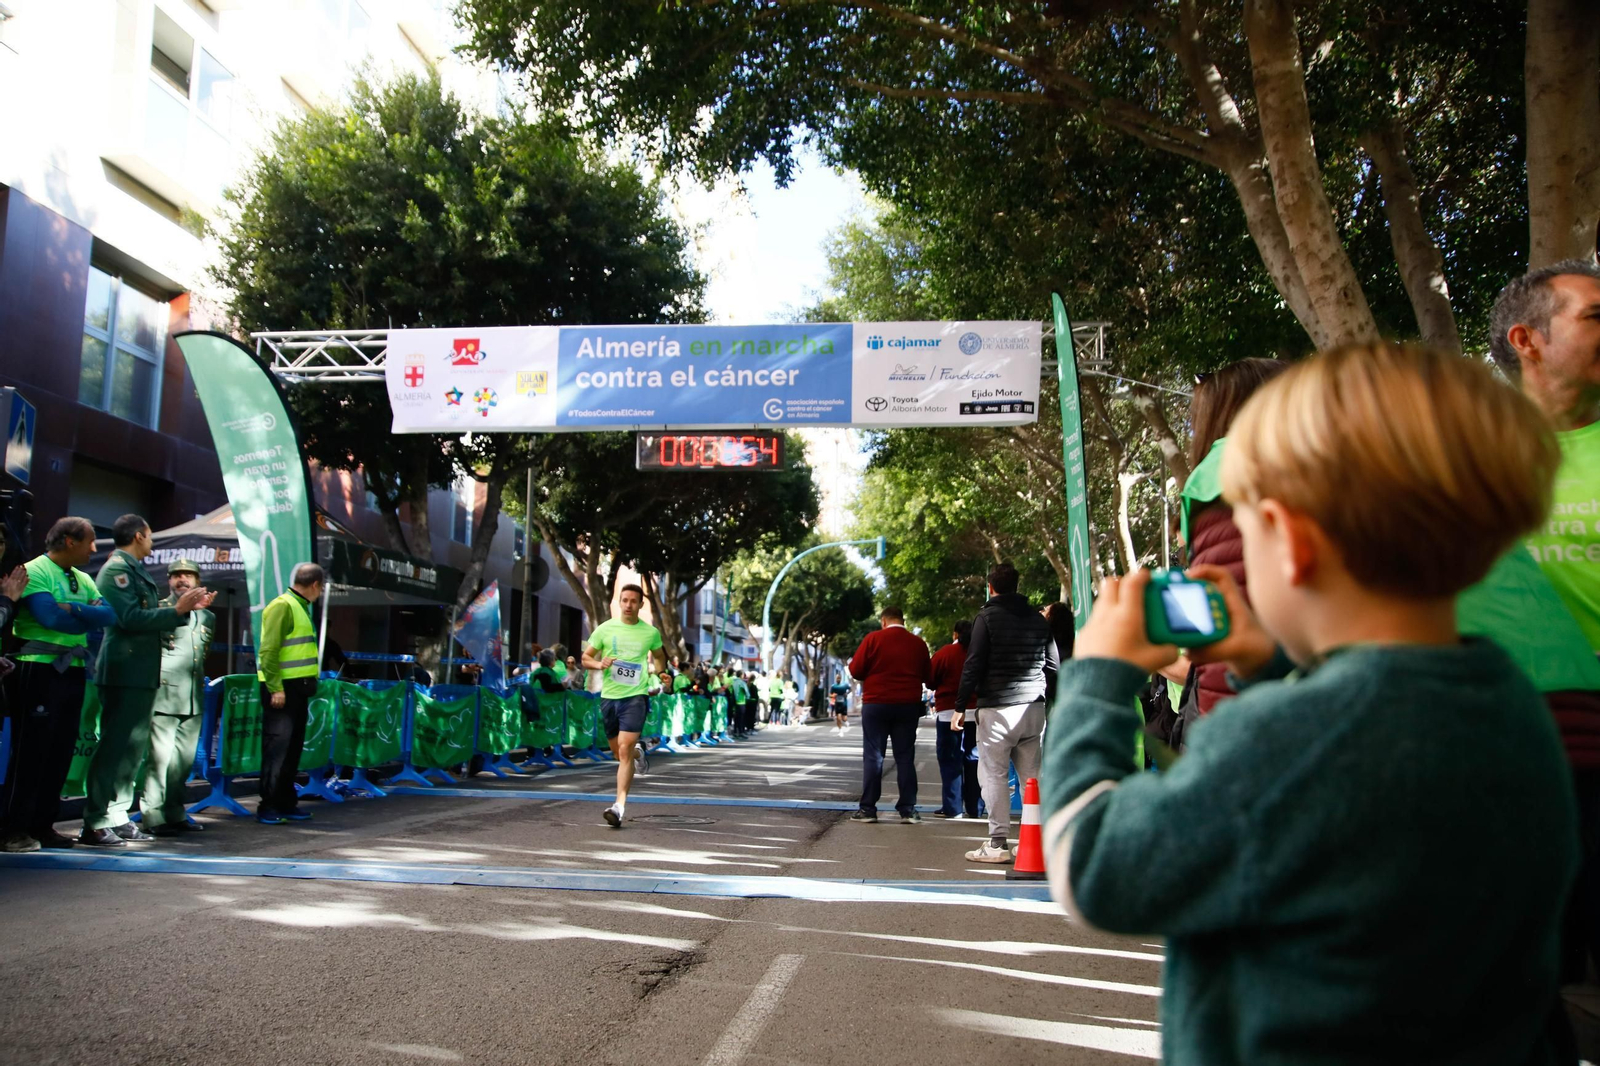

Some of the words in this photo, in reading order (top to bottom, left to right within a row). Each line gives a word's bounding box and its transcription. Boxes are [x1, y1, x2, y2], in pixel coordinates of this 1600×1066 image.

[575, 335, 681, 359] Almería
[689, 339, 722, 356] en
[731, 332, 835, 356] marcha
[887, 336, 942, 350] cajamar
[575, 366, 663, 389] contra
[670, 364, 697, 387] el
[703, 364, 800, 387] cáncer
[939, 367, 1002, 380] Fundación
[393, 391, 432, 401] ALMERÍA
[891, 396, 919, 404] Toyota
[971, 388, 993, 400] Ejido
[995, 388, 1023, 397] Motor
[567, 408, 655, 418] #TodosContraElCáncer
[1525, 539, 1600, 563] ánce
[616, 667, 636, 678] 633
